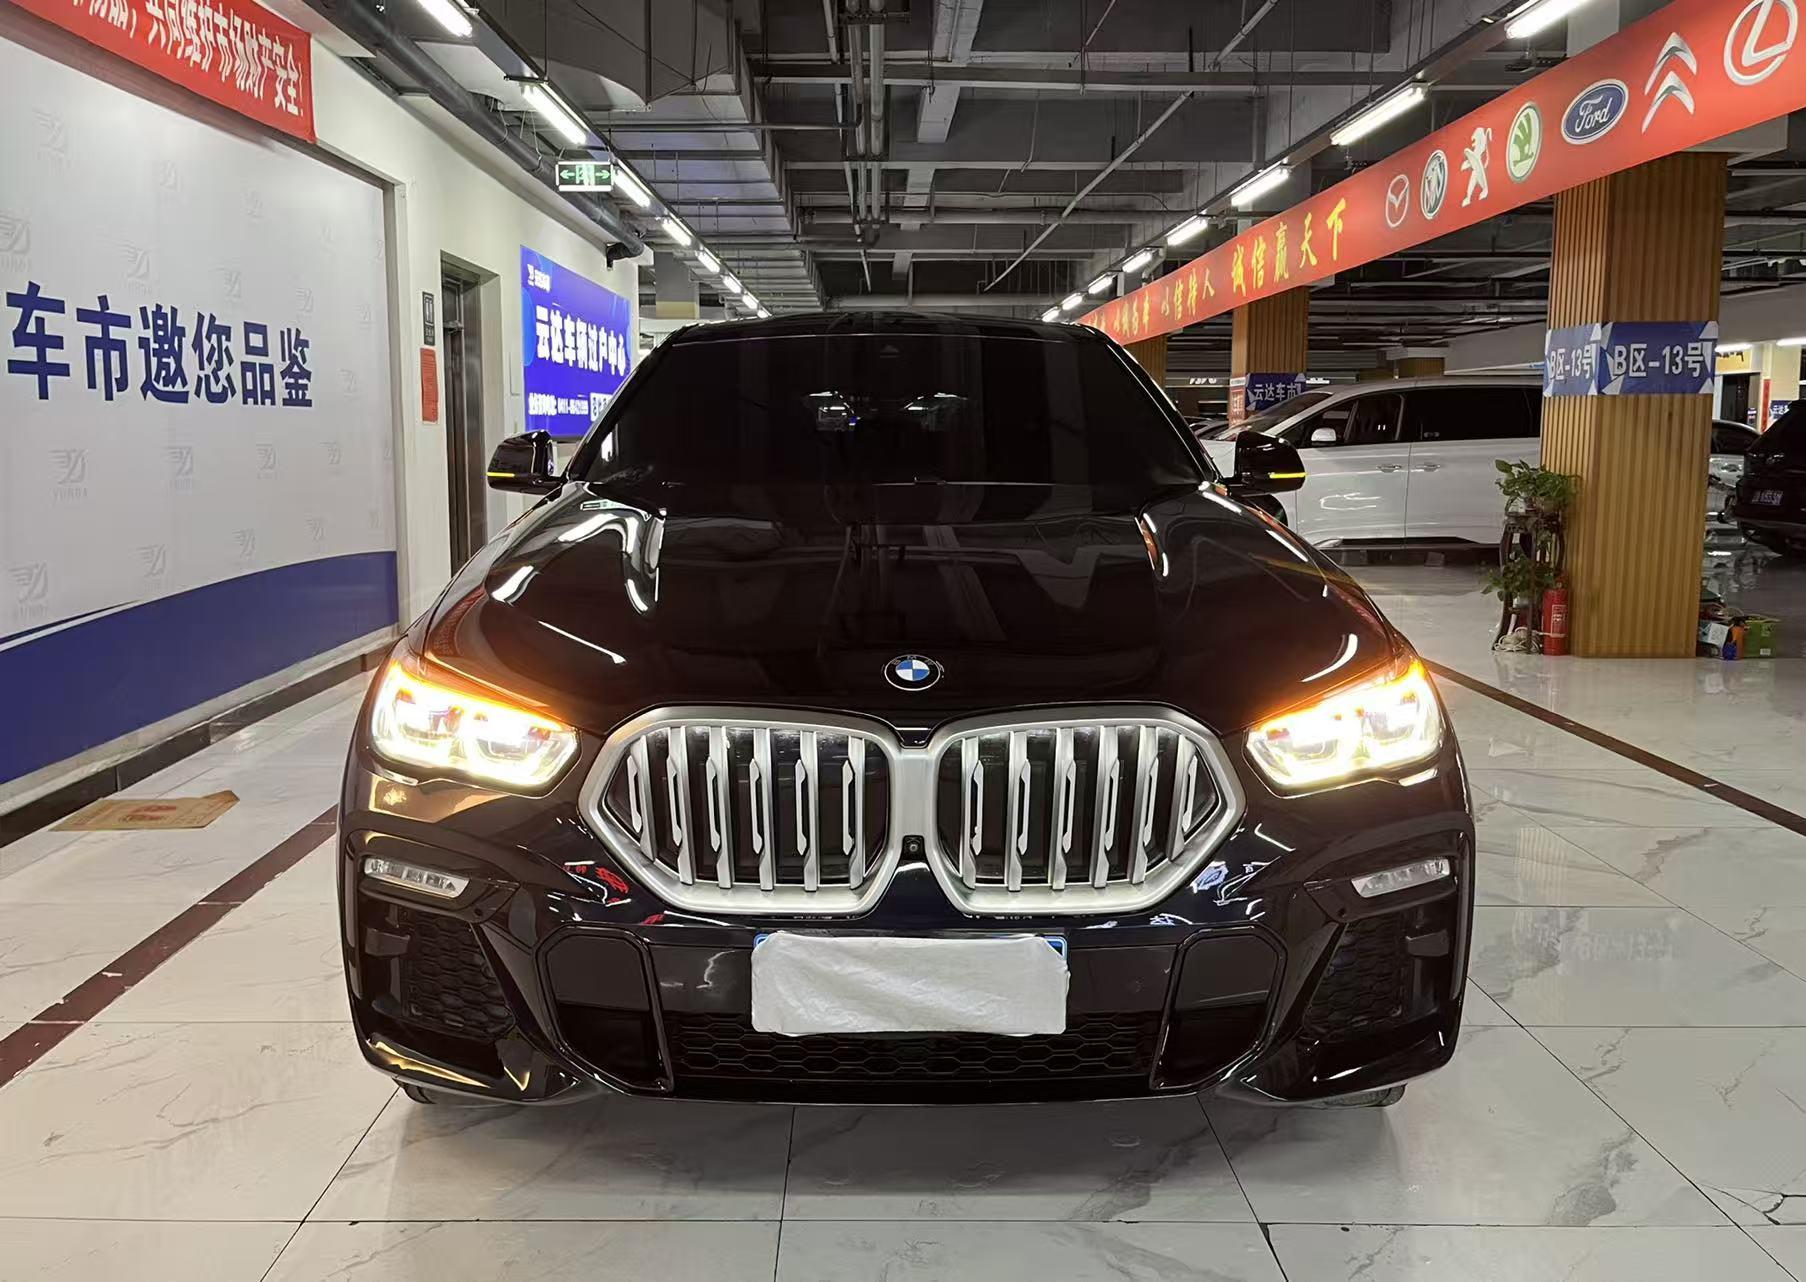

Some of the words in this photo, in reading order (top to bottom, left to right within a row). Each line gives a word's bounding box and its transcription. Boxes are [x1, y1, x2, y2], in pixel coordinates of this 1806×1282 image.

[1575, 96, 1612, 132] Ford
[6, 281, 312, 407] 车市邀您品鉴
[1549, 343, 1593, 381] B区-13号
[1612, 342, 1703, 378] B区-13号
